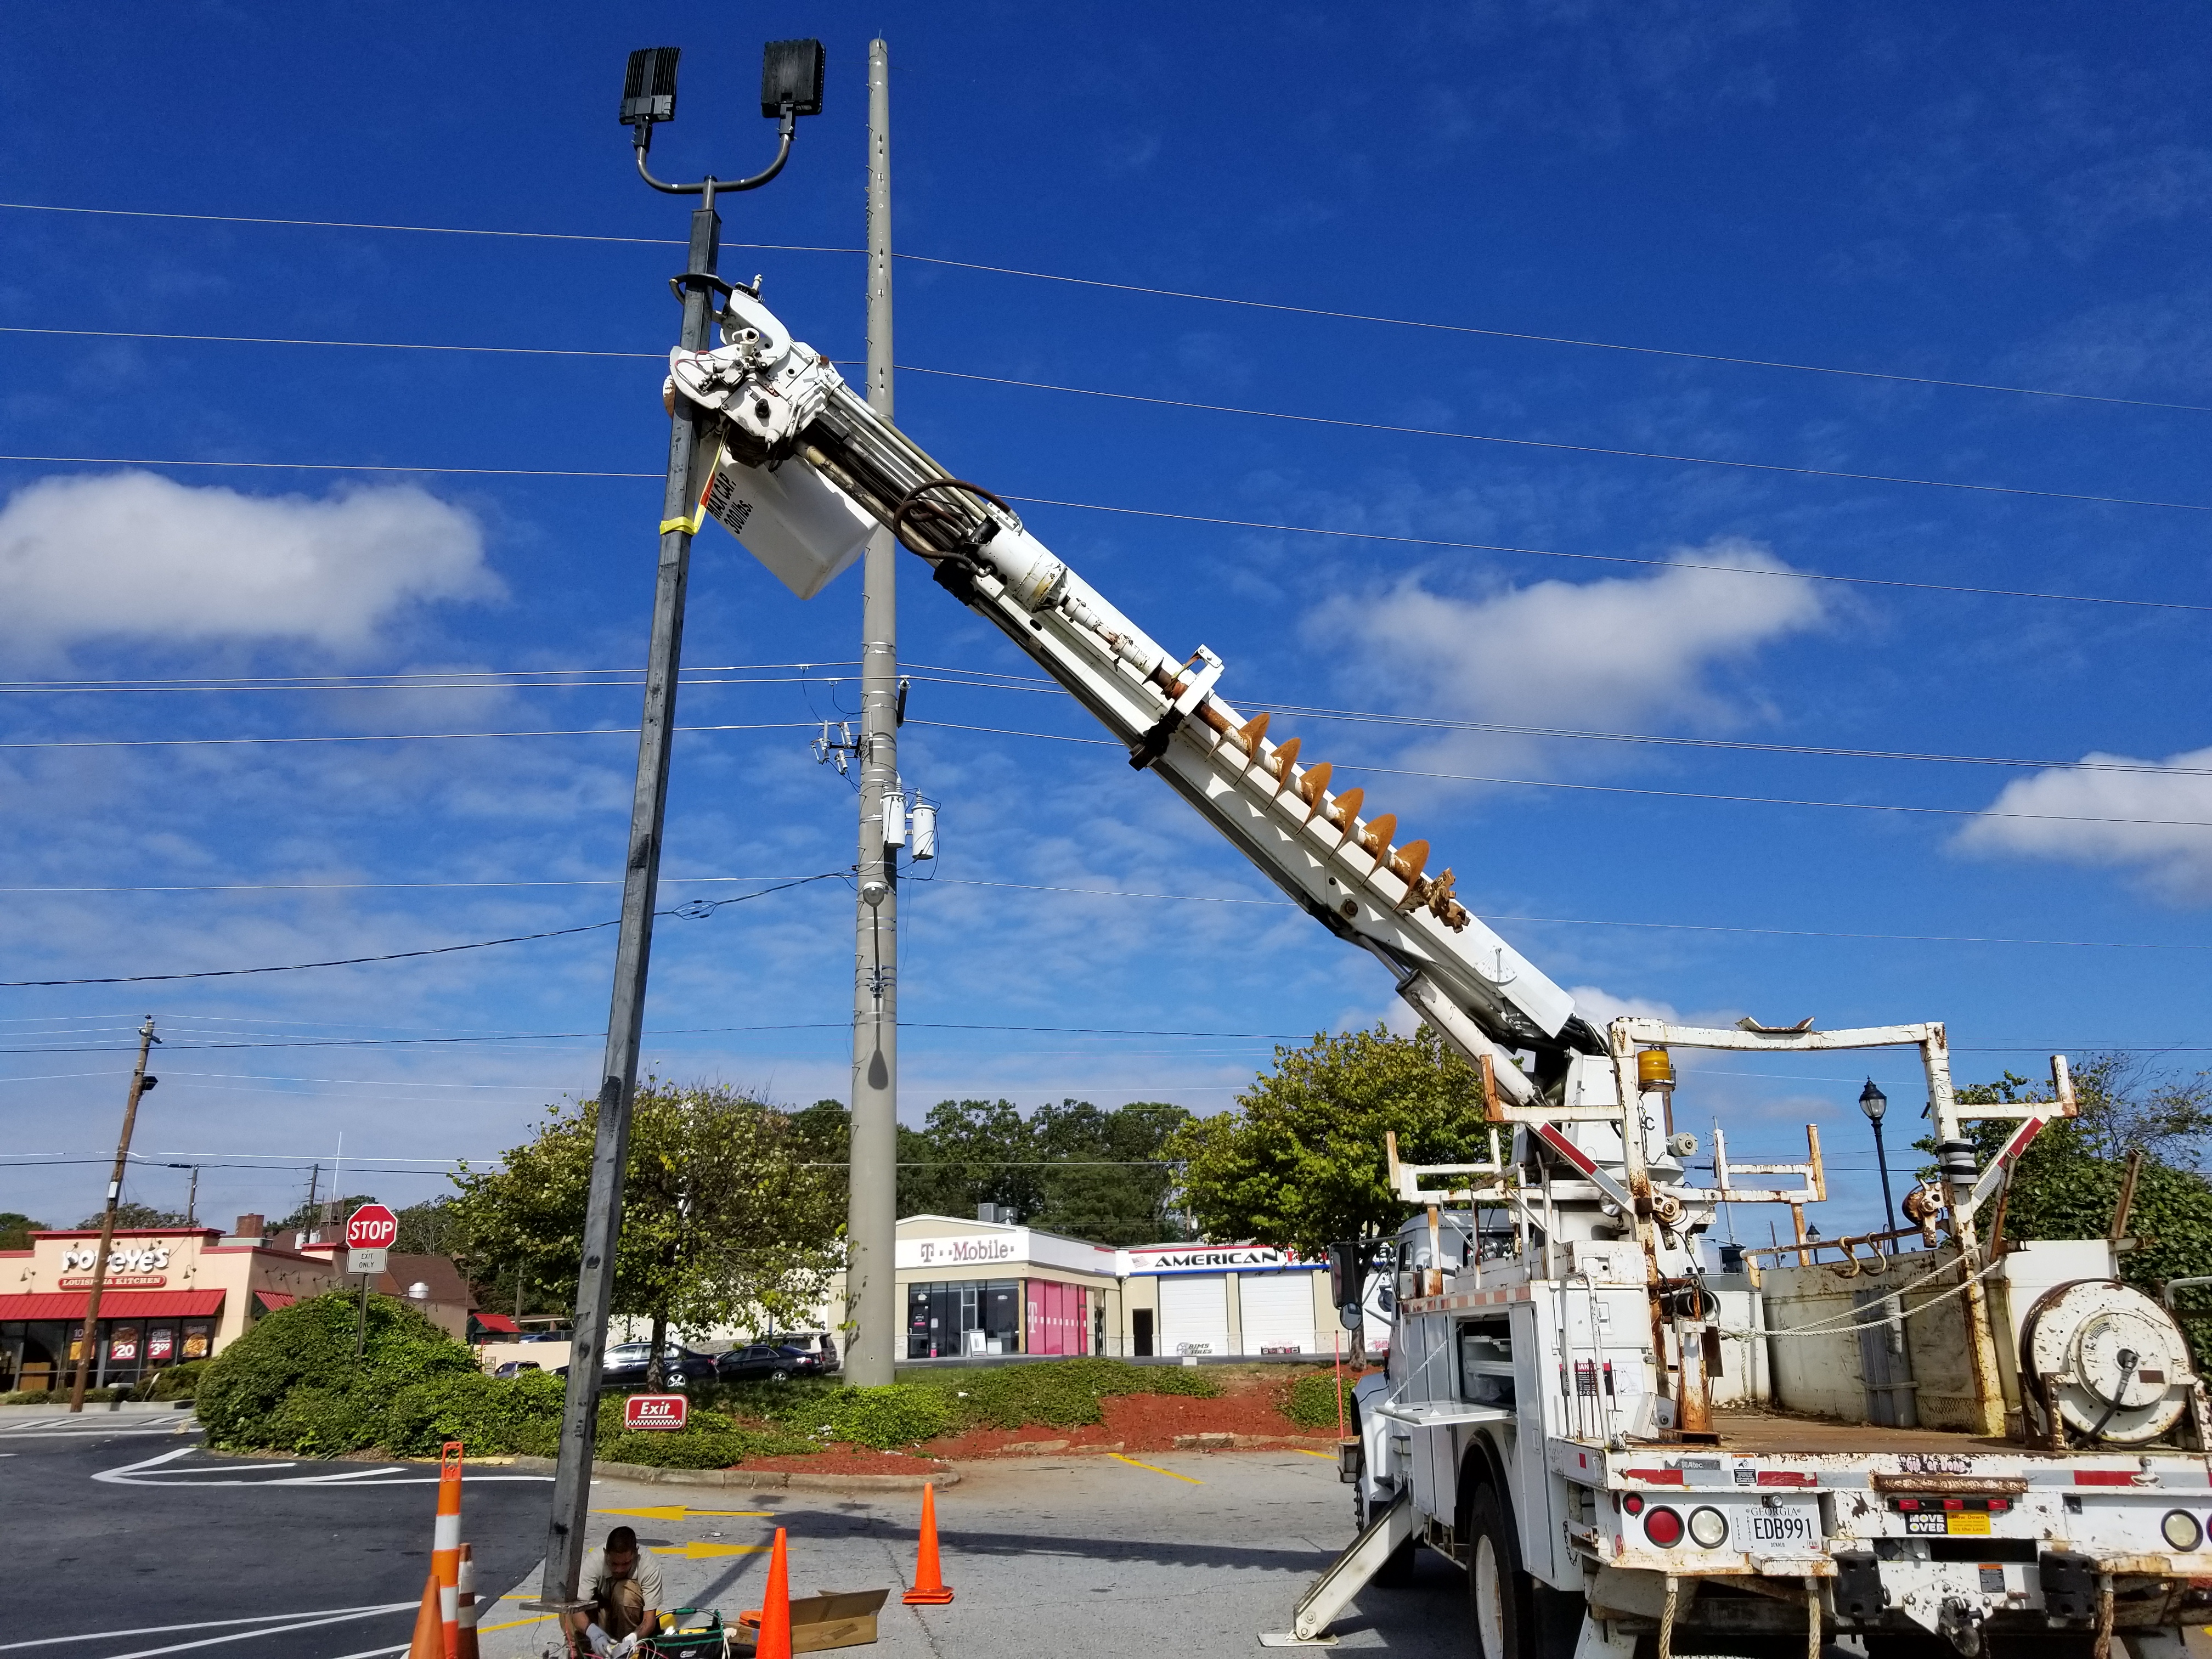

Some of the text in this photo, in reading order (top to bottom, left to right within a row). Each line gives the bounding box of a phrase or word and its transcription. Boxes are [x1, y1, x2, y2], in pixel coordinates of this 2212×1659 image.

[706, 472, 737, 521] MAX CAP.
[349, 1221, 393, 1240] STOP
[1155, 1251, 1278, 1267] AMERICAN
[115, 1345, 135, 1357] $20
[640, 1401, 670, 1414] Exit
[1751, 1507, 1798, 1516] GEORGIA
[1909, 1514, 1944, 1522] MOVE
[1754, 1517, 1812, 1539] EDB991
[1909, 1523, 1945, 1532] OVER
